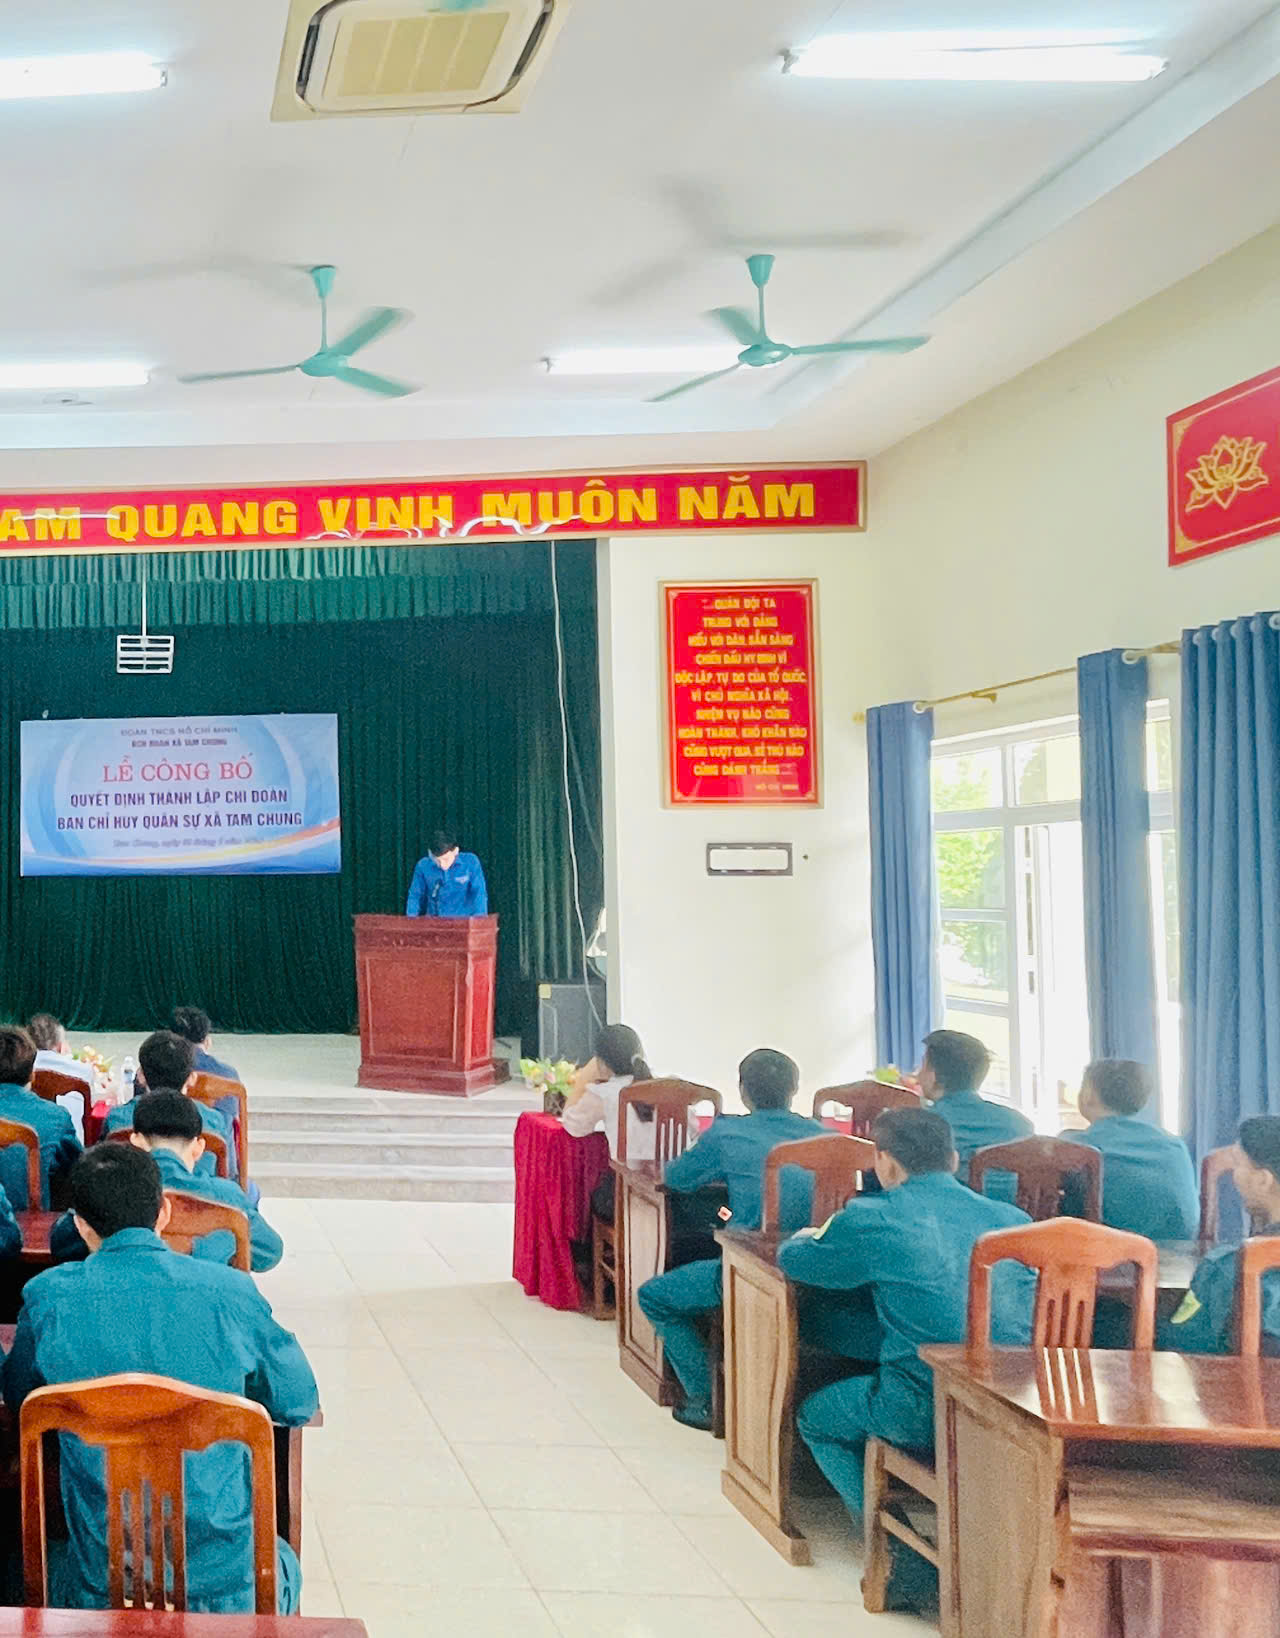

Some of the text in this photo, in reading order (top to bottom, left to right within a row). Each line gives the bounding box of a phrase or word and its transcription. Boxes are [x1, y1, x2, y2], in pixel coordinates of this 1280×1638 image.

[106, 502, 298, 542] QUANG
[319, 496, 454, 534] VINH
[481, 480, 657, 526] MUÔN
[678, 472, 815, 521] NĂM
[103, 753, 254, 783] LỄ CÔNG BỐ
[150, 788, 192, 805] THÀNH
[196, 787, 220, 807] LẬP
[225, 789, 246, 803] CHI
[58, 816, 84, 830] BAN
[88, 812, 110, 829] CHỈ
[114, 815, 138, 829] HUY
[143, 812, 178, 829] QUÂN
[183, 814, 201, 830] SỰ
[225, 813, 253, 826] TAM
[257, 811, 303, 826] CHUNG
